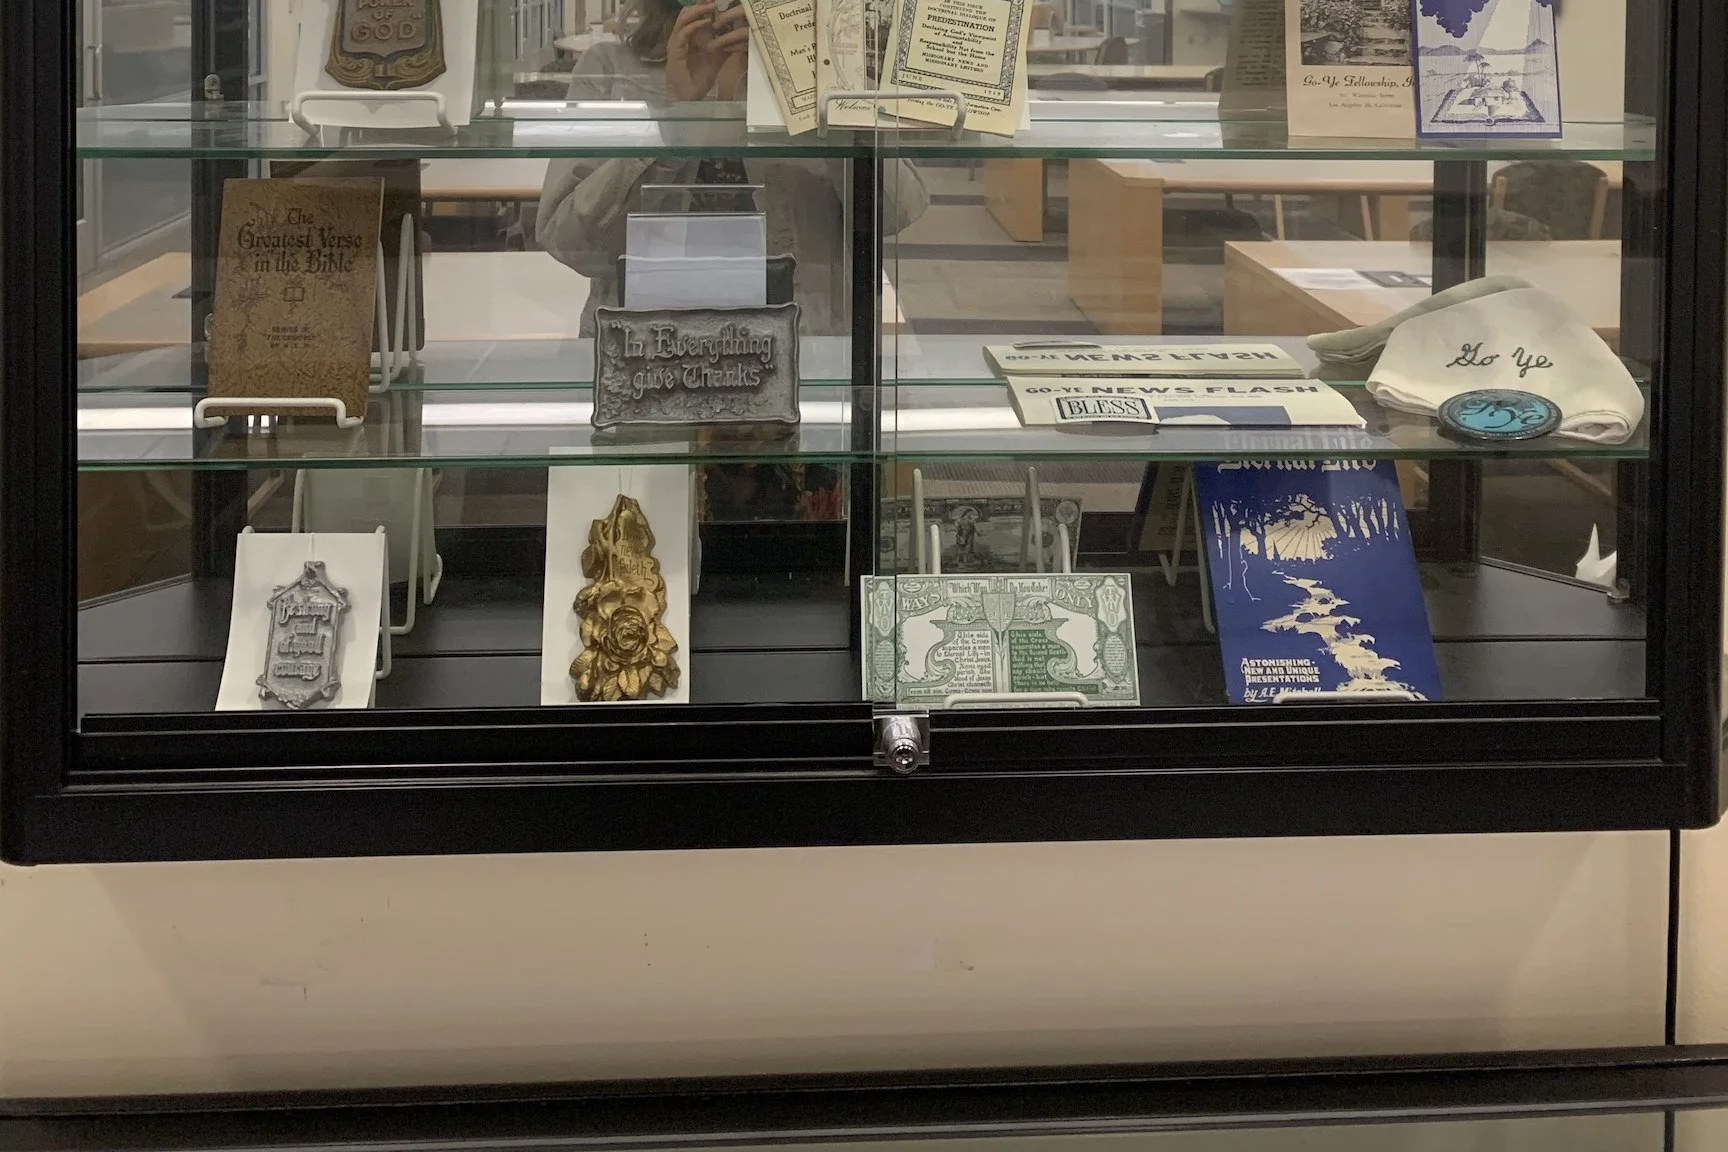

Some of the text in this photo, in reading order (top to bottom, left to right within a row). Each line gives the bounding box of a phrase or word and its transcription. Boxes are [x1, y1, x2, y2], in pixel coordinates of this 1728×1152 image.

[372, 8, 395, 20] OF
[778, 3, 813, 20] Doctrinal
[921, 22, 949, 34] Declaring
[926, 13, 996, 33] PREDESTINATION
[790, 44, 812, 57] Man's
[957, 50, 968, 58] the
[901, 73, 923, 81] JUNE
[1343, 74, 1399, 89] Fellowship,
[286, 207, 314, 226] The
[237, 218, 363, 250] Greatest Verse
[254, 247, 354, 274] in the Bible
[650, 324, 774, 364] Everything
[1445, 341, 1554, 378] Go Ye
[632, 366, 675, 399] give
[1025, 385, 1319, 394] GO-YE NEWS FLASH
[1055, 587, 1096, 608] ONLY
[1244, 664, 1321, 676] NEW AND UNIQUE
[1244, 674, 1320, 686] PRESENTATIONS
[1243, 687, 1259, 702] by
